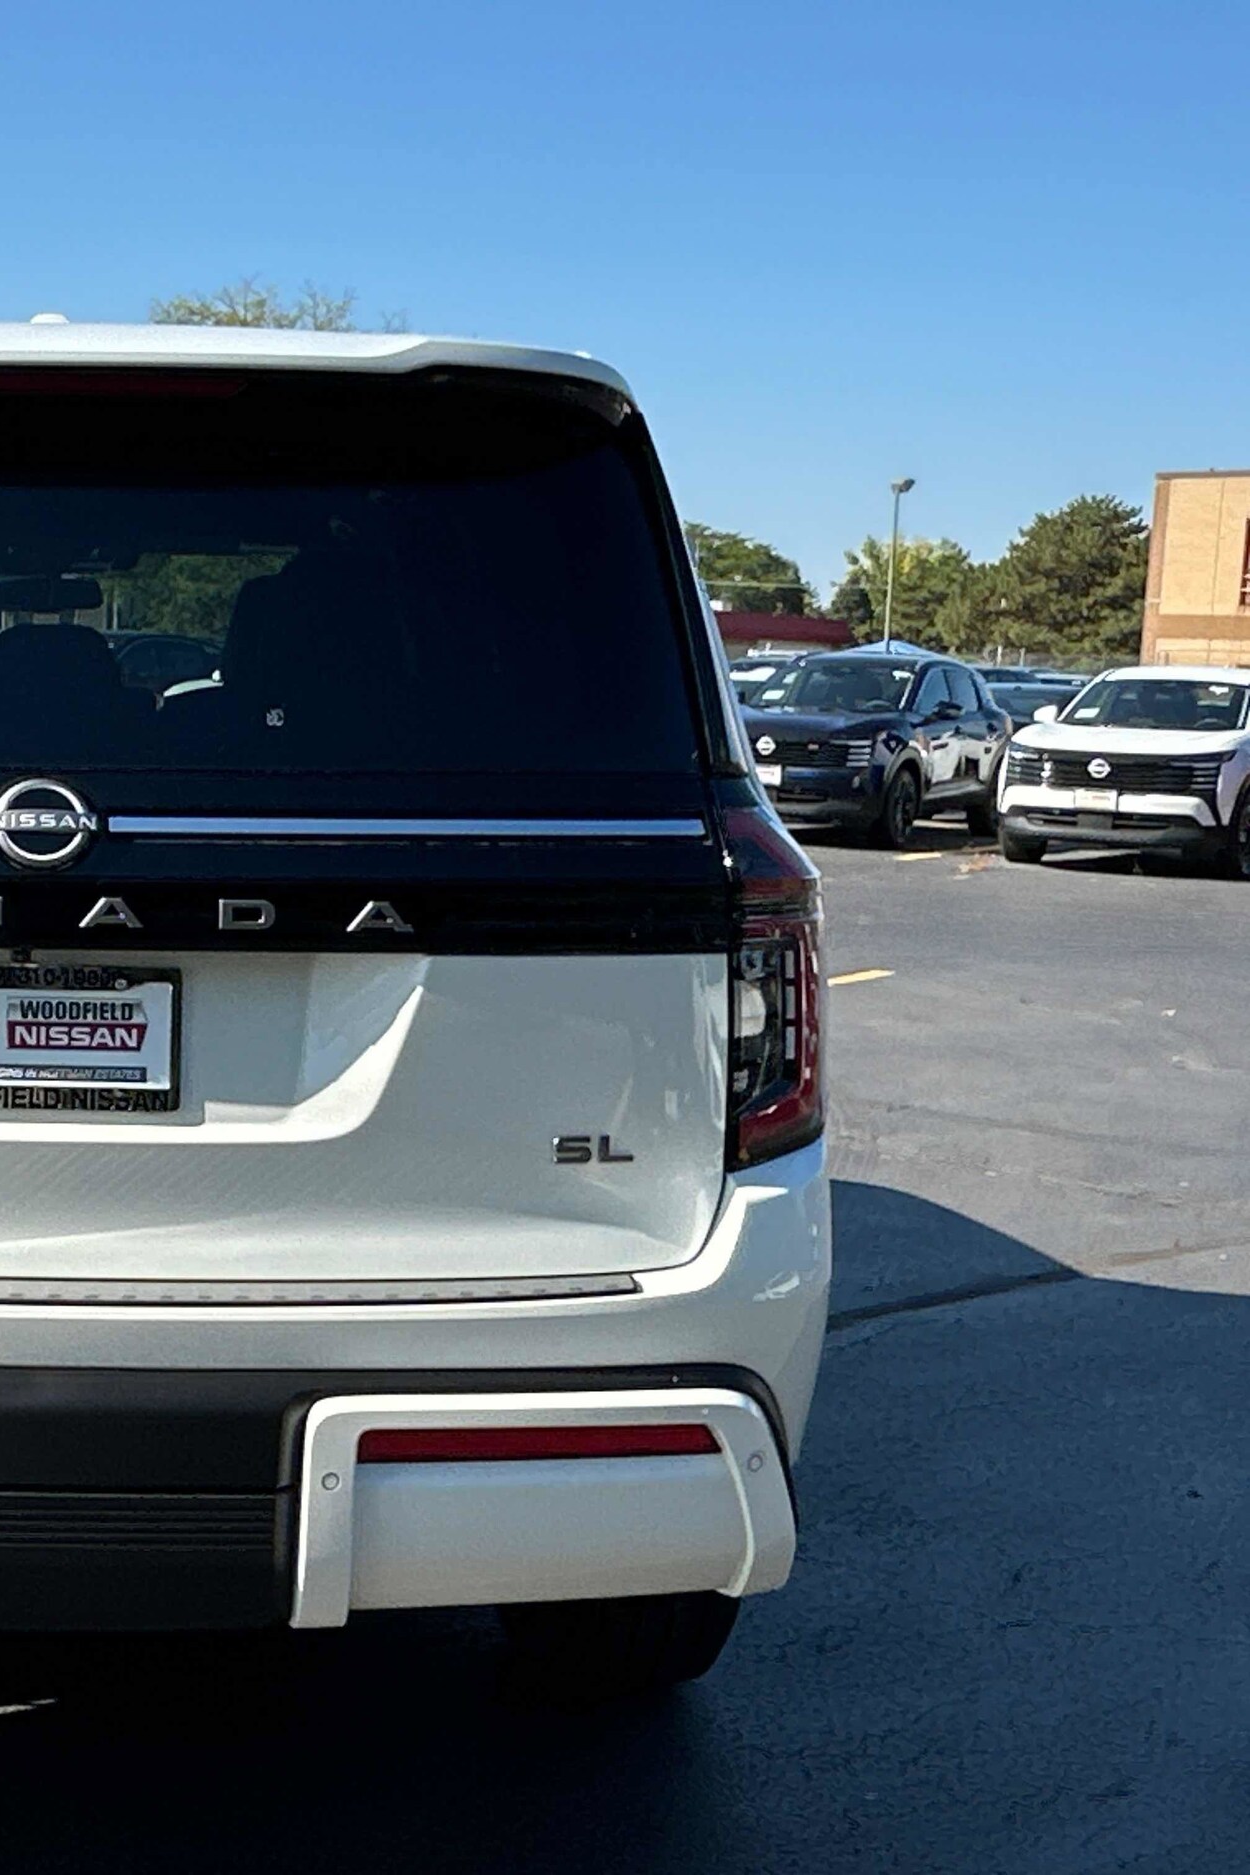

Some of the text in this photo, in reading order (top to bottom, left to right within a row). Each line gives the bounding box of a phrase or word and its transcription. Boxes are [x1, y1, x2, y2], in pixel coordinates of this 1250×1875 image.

[19, 999, 134, 1021] WOODFIELD
[14, 1025, 139, 1048] NISSAN
[65, 1087, 170, 1112] NISSAN
[552, 1134, 634, 1164] SL
